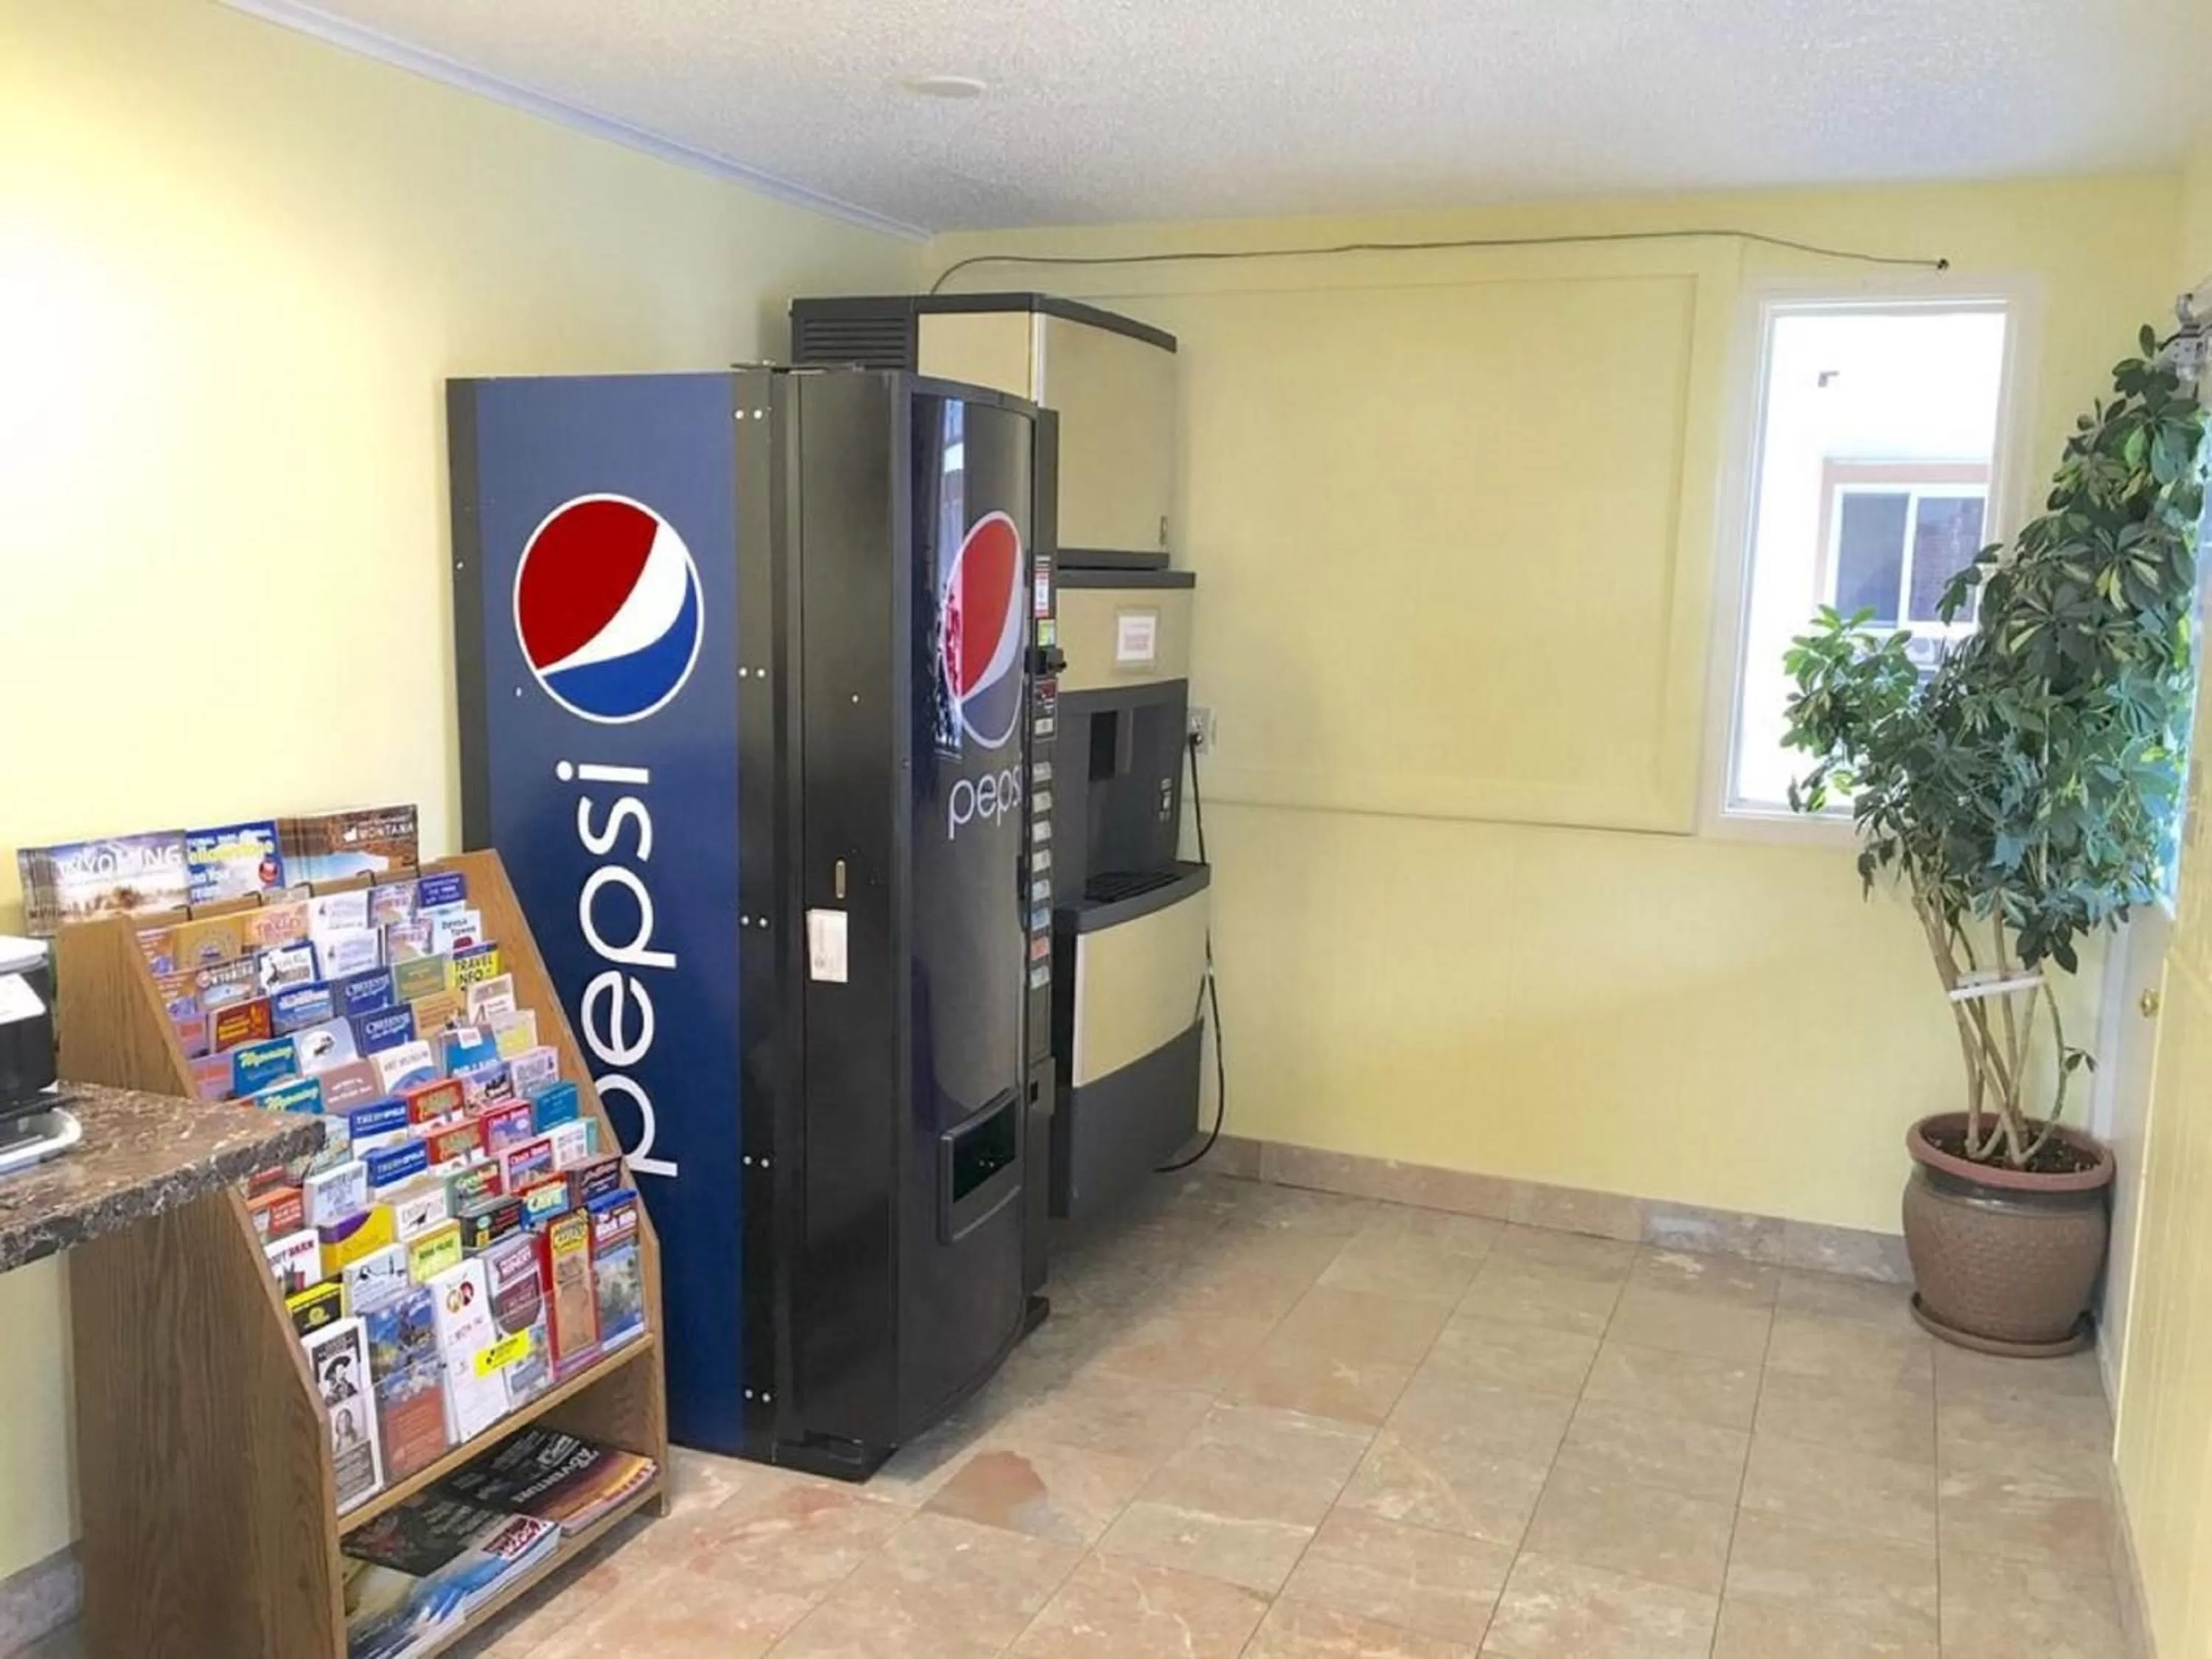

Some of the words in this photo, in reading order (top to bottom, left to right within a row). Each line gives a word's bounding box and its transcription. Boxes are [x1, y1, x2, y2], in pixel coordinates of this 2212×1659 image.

[60, 845, 181, 875] WYONG
[453, 954, 494, 971] TRAVEL
[557, 761, 677, 1177] pepsi
